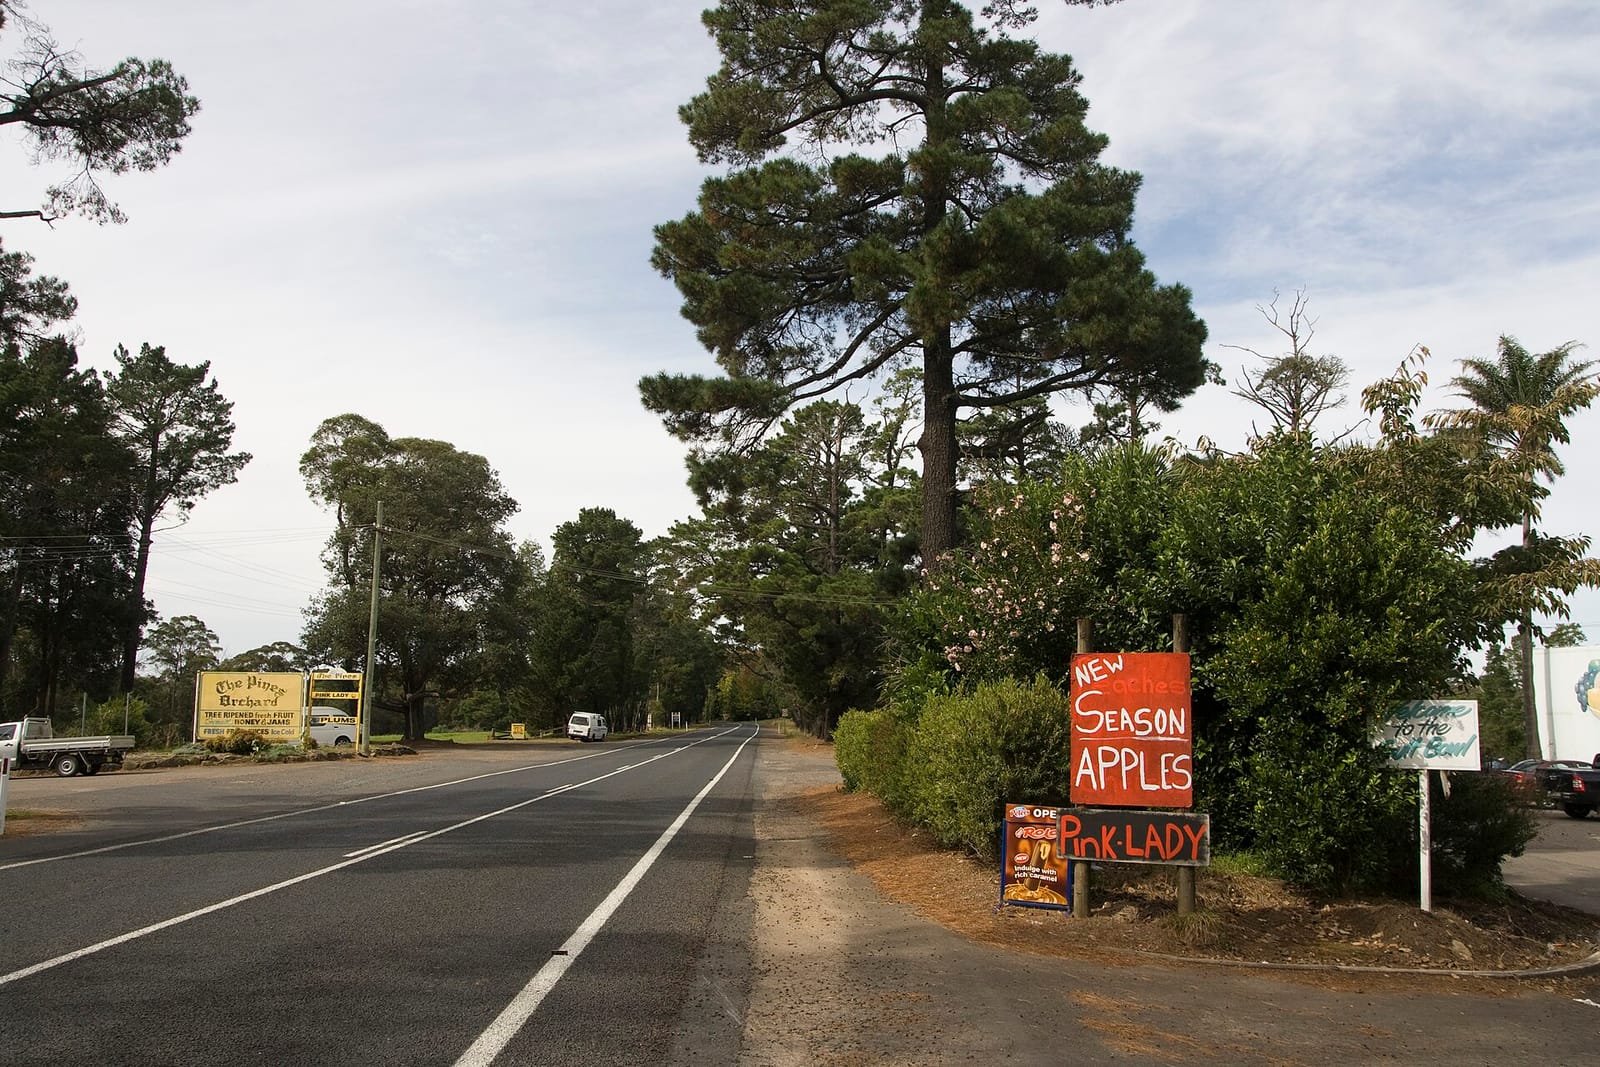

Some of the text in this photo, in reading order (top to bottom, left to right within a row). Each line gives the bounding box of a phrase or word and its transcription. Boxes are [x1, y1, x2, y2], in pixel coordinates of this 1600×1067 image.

[1075, 654, 1124, 688] NEW
[216, 676, 287, 697] The Pines
[219, 695, 279, 708] Orchard
[204, 711, 222, 719] TREE
[223, 711, 254, 719] RIPENED
[255, 711, 272, 719] fresh
[1074, 690, 1186, 736] SEASON
[1391, 716, 1452, 738] to the
[1423, 734, 1477, 759] Bowl
[1075, 746, 1193, 791] APPLES
[1014, 865, 1041, 873] Indulge
[1029, 873, 1058, 882] caramel
